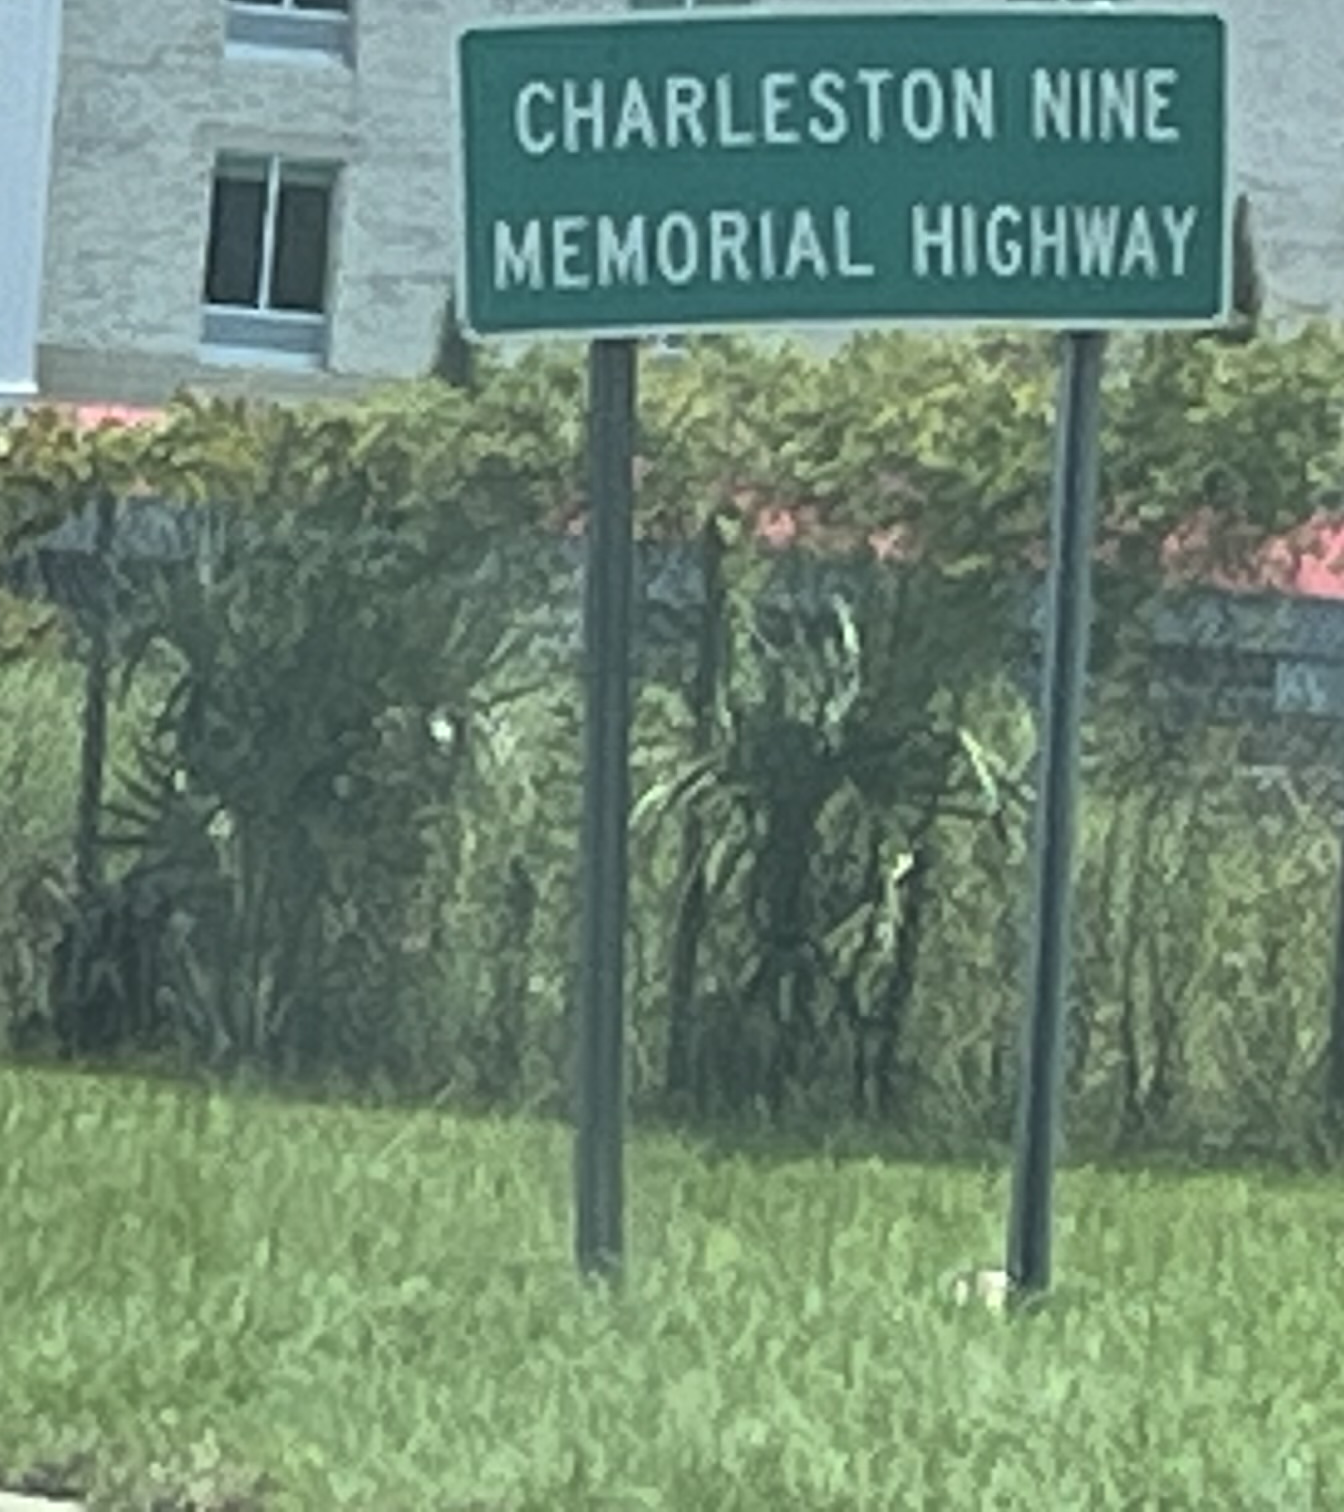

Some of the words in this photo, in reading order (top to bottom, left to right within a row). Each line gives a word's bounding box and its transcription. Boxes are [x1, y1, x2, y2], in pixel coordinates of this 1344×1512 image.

[513, 67, 995, 155] CHARLESTON
[1031, 67, 1181, 143] NINE
[493, 204, 876, 289] MEMORIAL
[910, 204, 1198, 278] HIGHWAY
